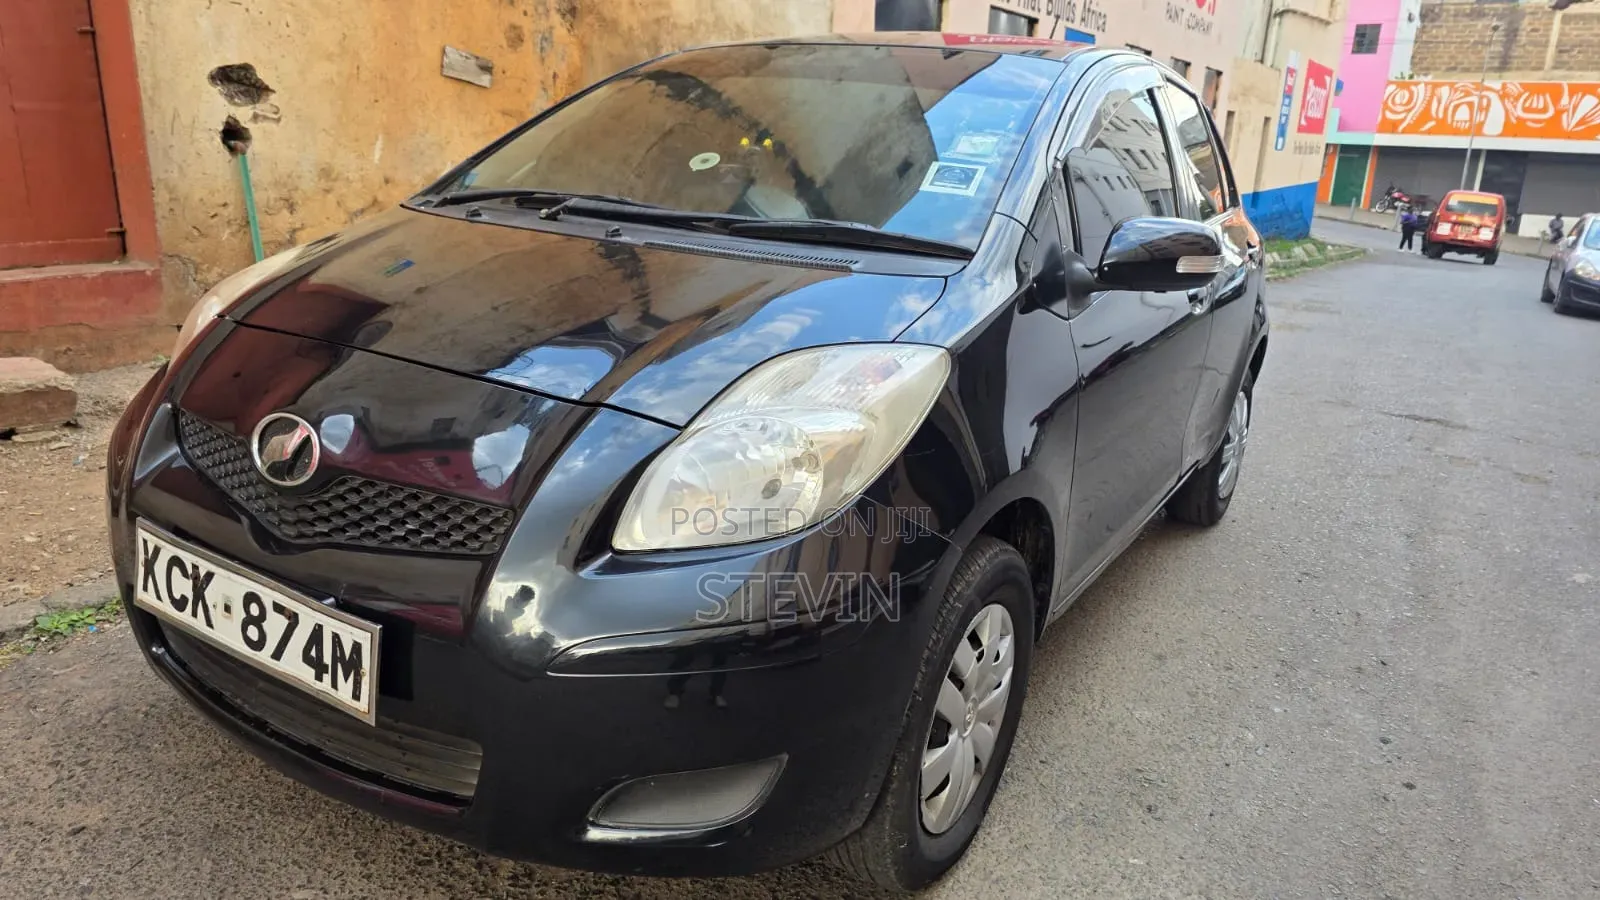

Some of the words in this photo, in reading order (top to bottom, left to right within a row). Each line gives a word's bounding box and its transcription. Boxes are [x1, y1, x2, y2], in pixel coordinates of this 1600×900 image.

[1080, 0, 1107, 33] Africa
[141, 537, 215, 630] KCK
[240, 590, 363, 702] 874M
